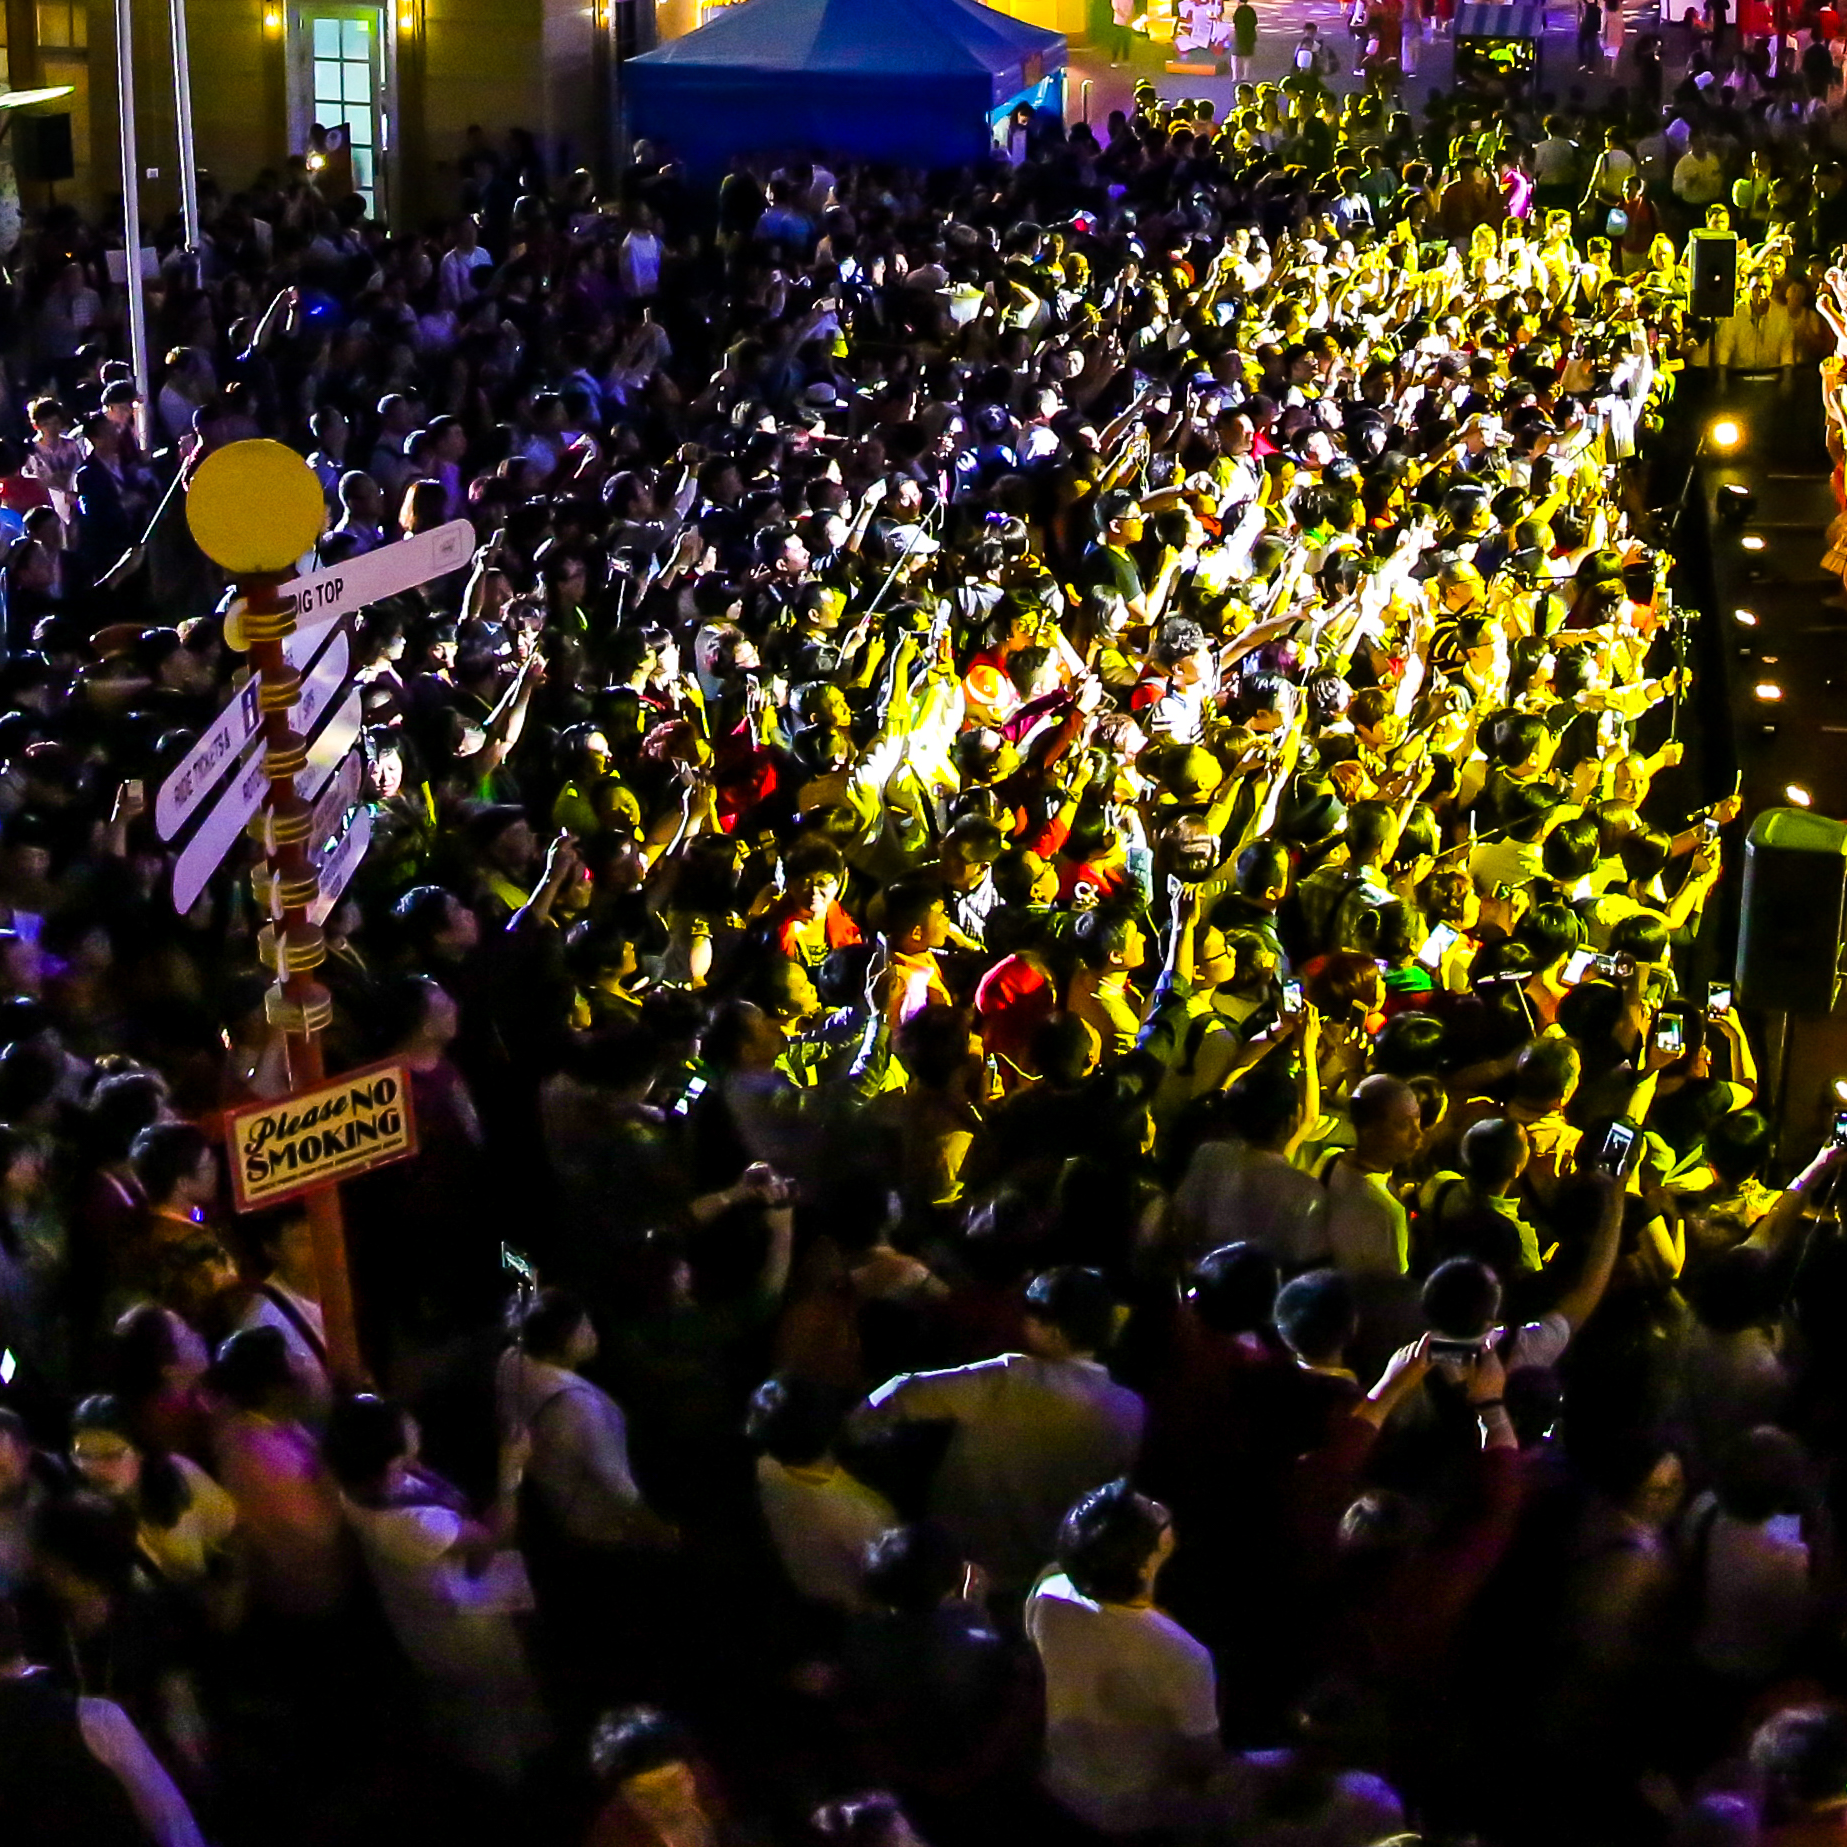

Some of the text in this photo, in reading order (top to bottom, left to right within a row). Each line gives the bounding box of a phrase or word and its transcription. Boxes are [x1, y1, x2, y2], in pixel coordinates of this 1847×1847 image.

[316, 577, 344, 609] TOP
[243, 1076, 397, 1154] Please NO
[245, 1106, 402, 1183] SMOKING
